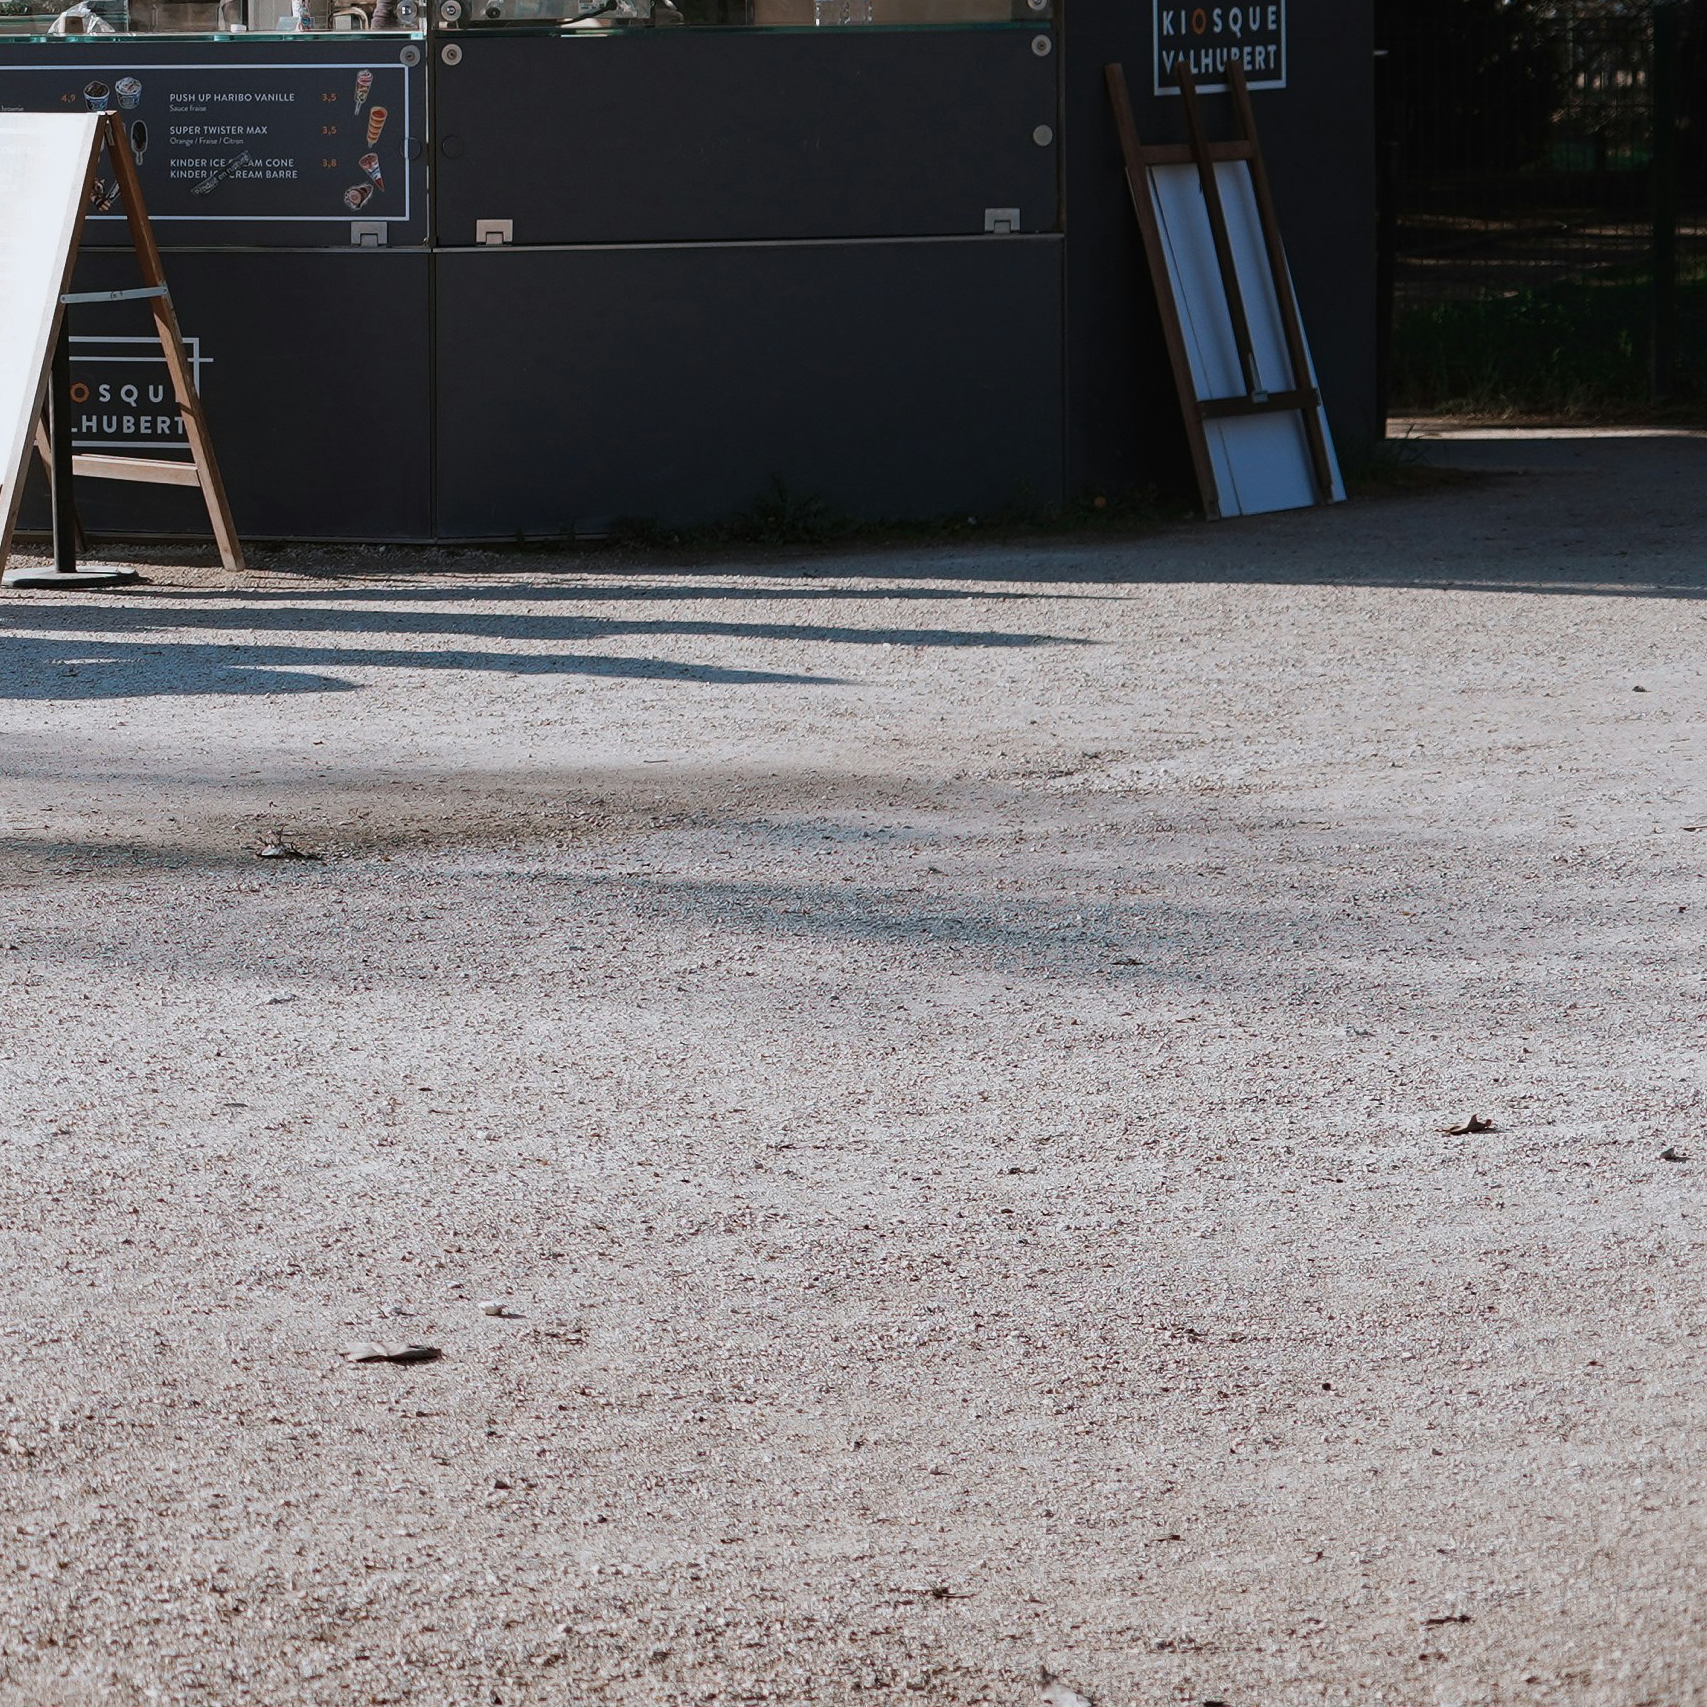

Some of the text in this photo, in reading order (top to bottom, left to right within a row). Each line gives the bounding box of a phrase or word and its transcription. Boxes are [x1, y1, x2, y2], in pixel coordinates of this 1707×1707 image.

[1162, 5, 1277, 38] KIOSQUE
[61, 94, 76, 103] 4,9
[169, 93, 337, 103] PUSH UP HARIBO VANILLE 3,5
[169, 104, 207, 112] Sauce fraise
[169, 126, 337, 135] SUPER TWISTER MAX 3,5
[169, 137, 194, 147] Orange
[199, 137, 218, 145] Fraise
[223, 137, 244, 145] Citron
[170, 158, 207, 167] KINDER
[209, 158, 226, 167] ICE
[265, 158, 295, 167] CONE
[322, 158, 337, 168] 3,8
[170, 170, 207, 179] KINDER
[265, 170, 299, 179] BARRE
[70, 382, 165, 407] OSQU
[71, 415, 185, 434] HUBERT
